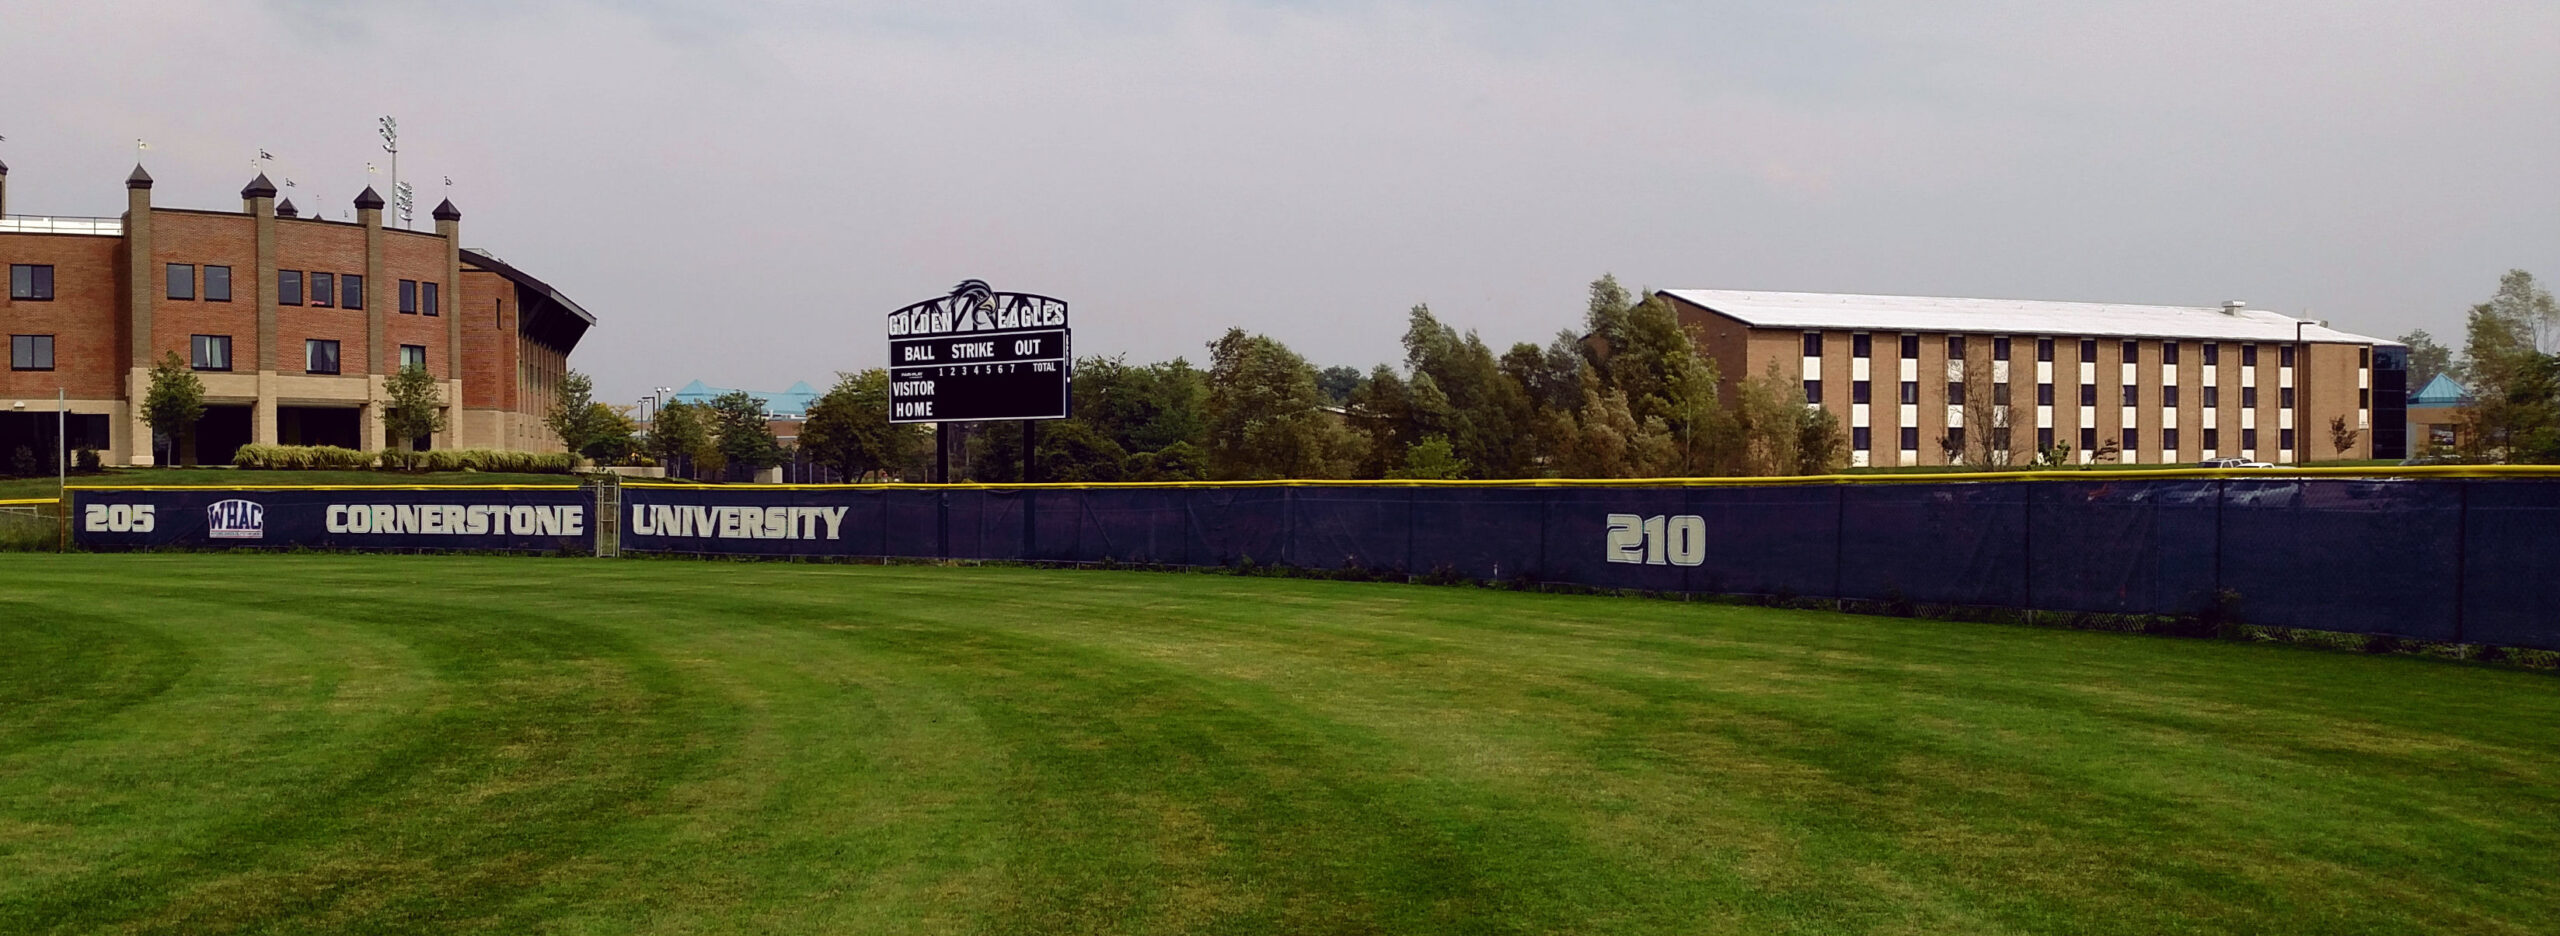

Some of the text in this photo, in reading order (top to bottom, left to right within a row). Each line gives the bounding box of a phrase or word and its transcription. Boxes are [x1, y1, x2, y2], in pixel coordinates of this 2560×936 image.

[889, 303, 1065, 335] GOLDEN EAGLES
[905, 339, 1041, 361] BALL STRIKE OUT
[938, 362, 1056, 376] 1 2 3 4 5 6 7 TOTAL
[893, 381, 935, 397] VISITOR
[896, 401, 933, 417] HOME
[85, 504, 155, 532] 205
[209, 501, 262, 530] WHAC
[326, 504, 848, 540] CORNERSTONE UNIVERSITY
[1607, 513, 1706, 566] 210
